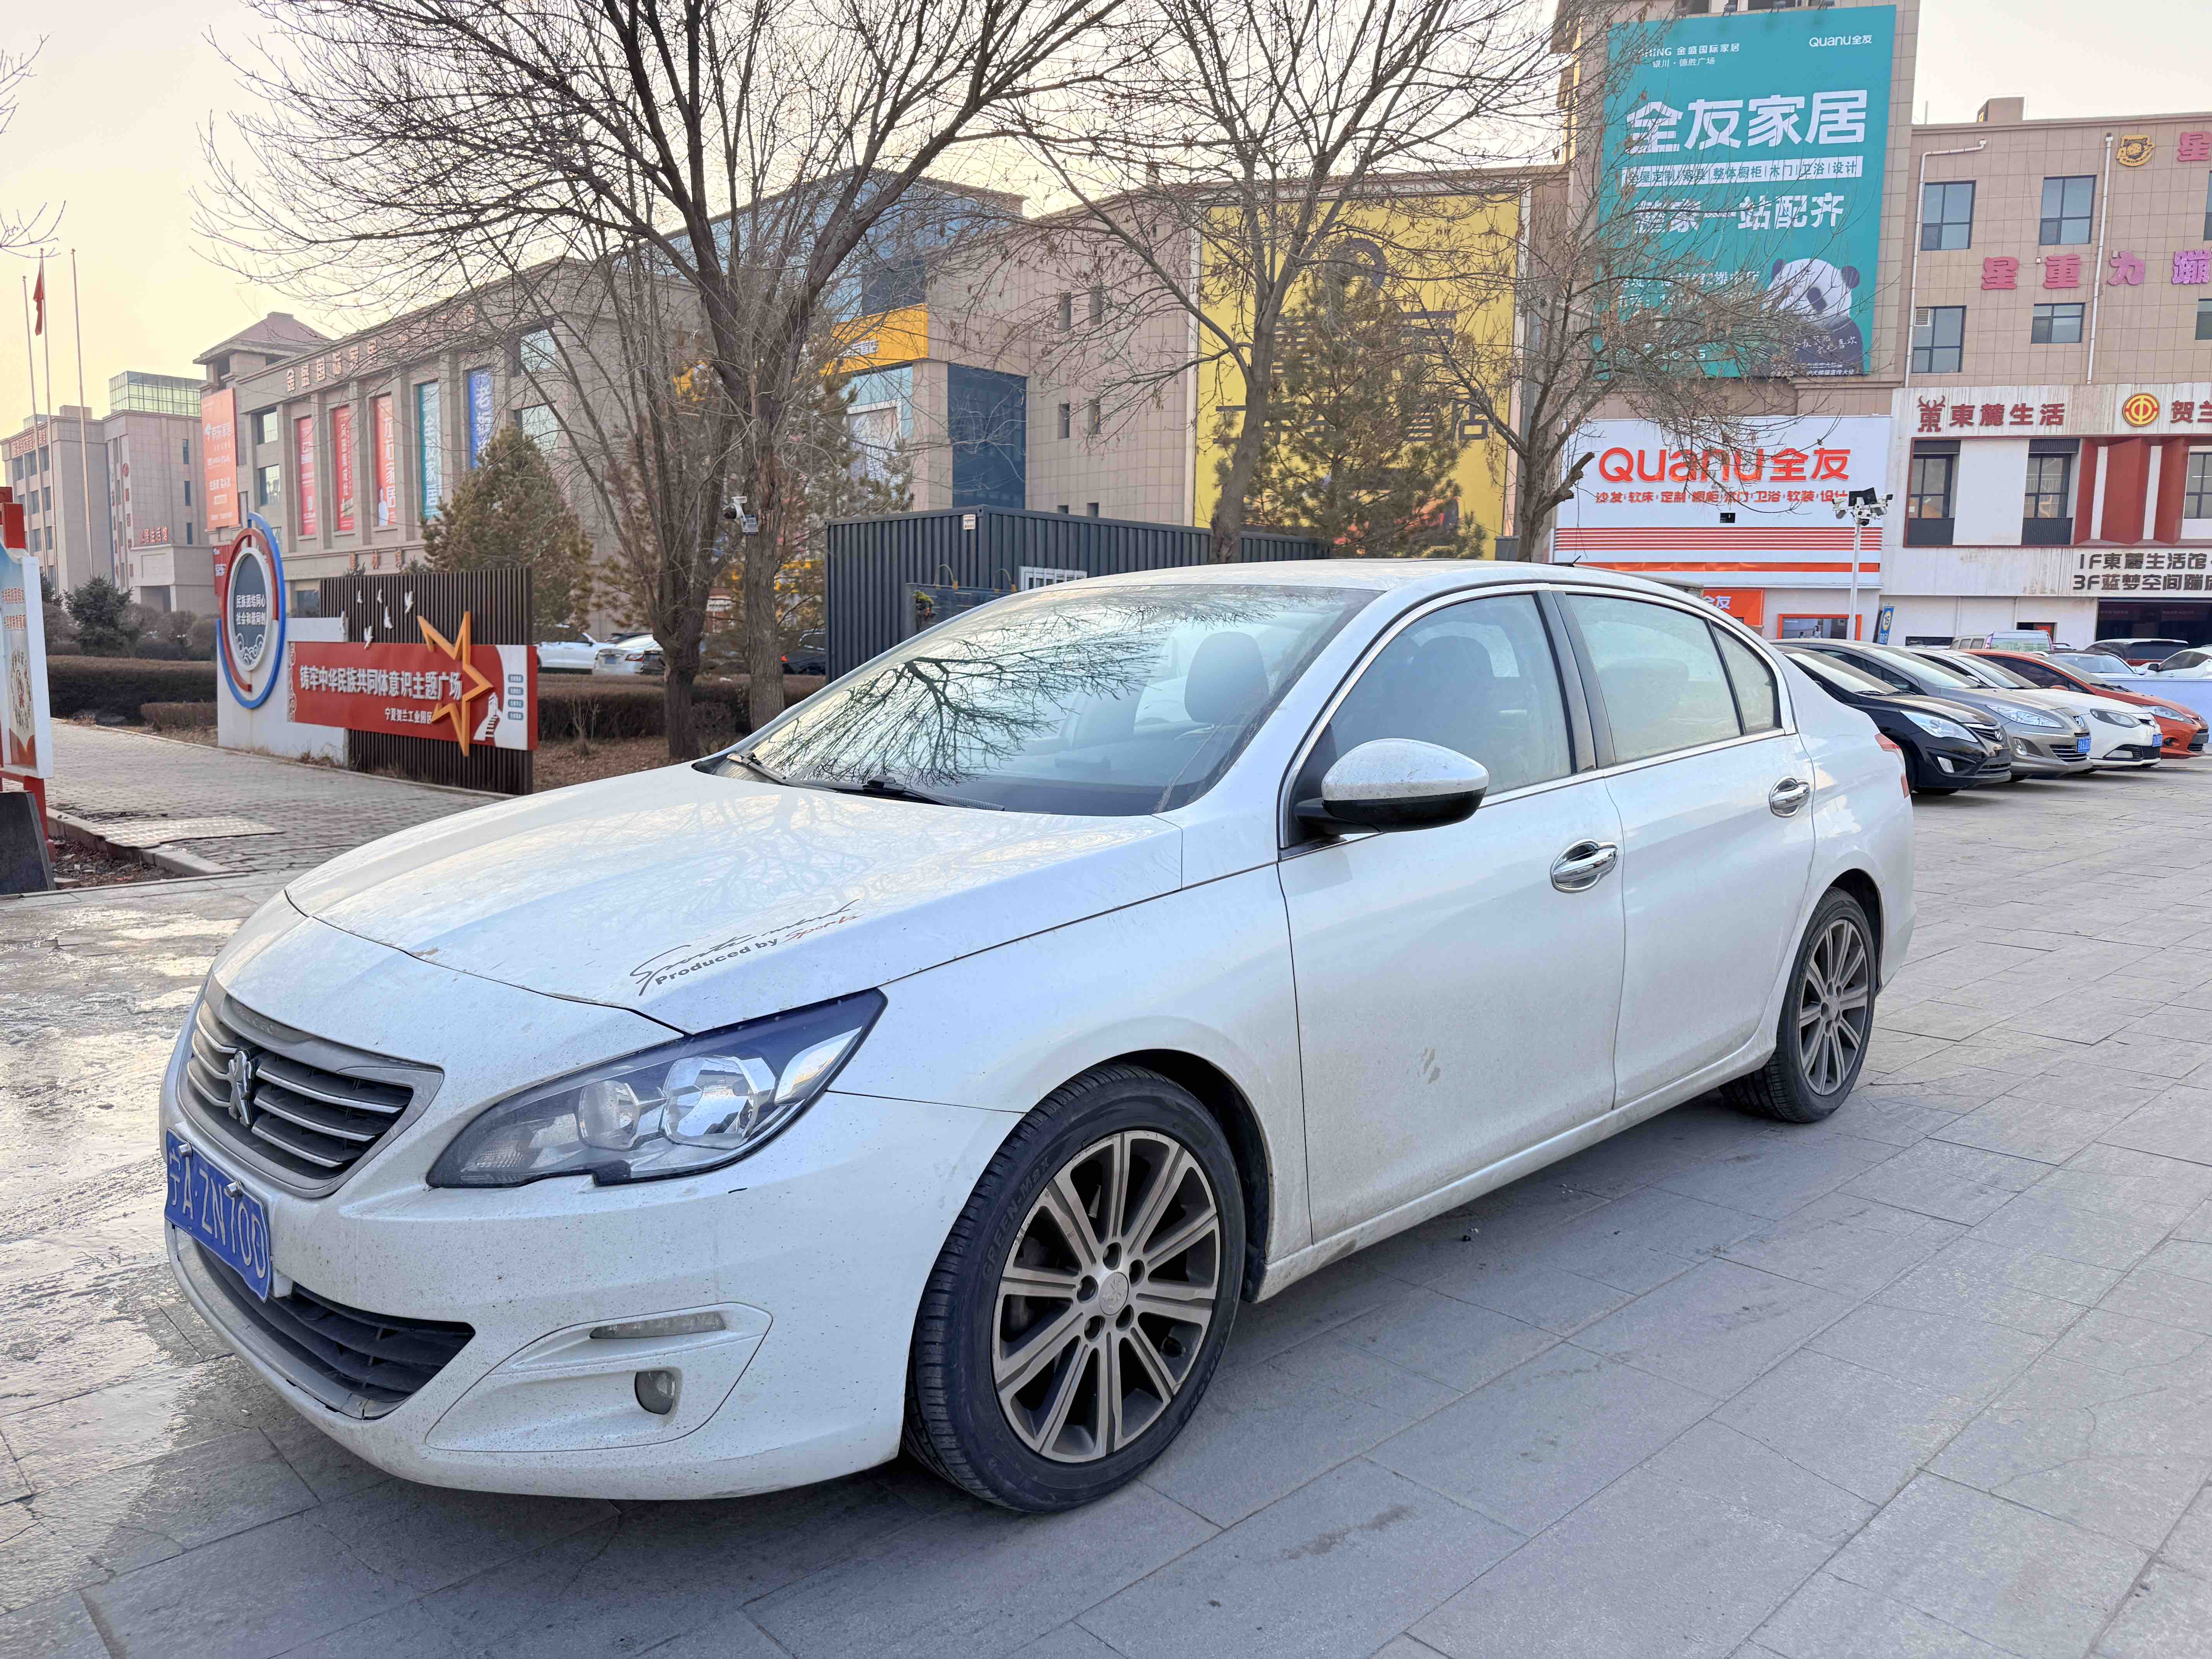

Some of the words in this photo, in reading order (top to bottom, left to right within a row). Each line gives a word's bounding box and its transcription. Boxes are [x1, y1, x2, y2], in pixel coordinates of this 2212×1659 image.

[1676, 43, 1740, 56] 金盛国际家居
[1809, 35, 1872, 47] Quanu全友
[1626, 89, 1868, 154] 全友家居
[236, 594, 266, 608] 民族团结同心
[300, 665, 462, 701] 铸牢中华民族共同体意识主题广场
[385, 707, 433, 725] 宁夏贺兰工业园区
[655, 946, 751, 985] Produced
[755, 938, 778, 951] by
[778, 913, 866, 945] Sports
